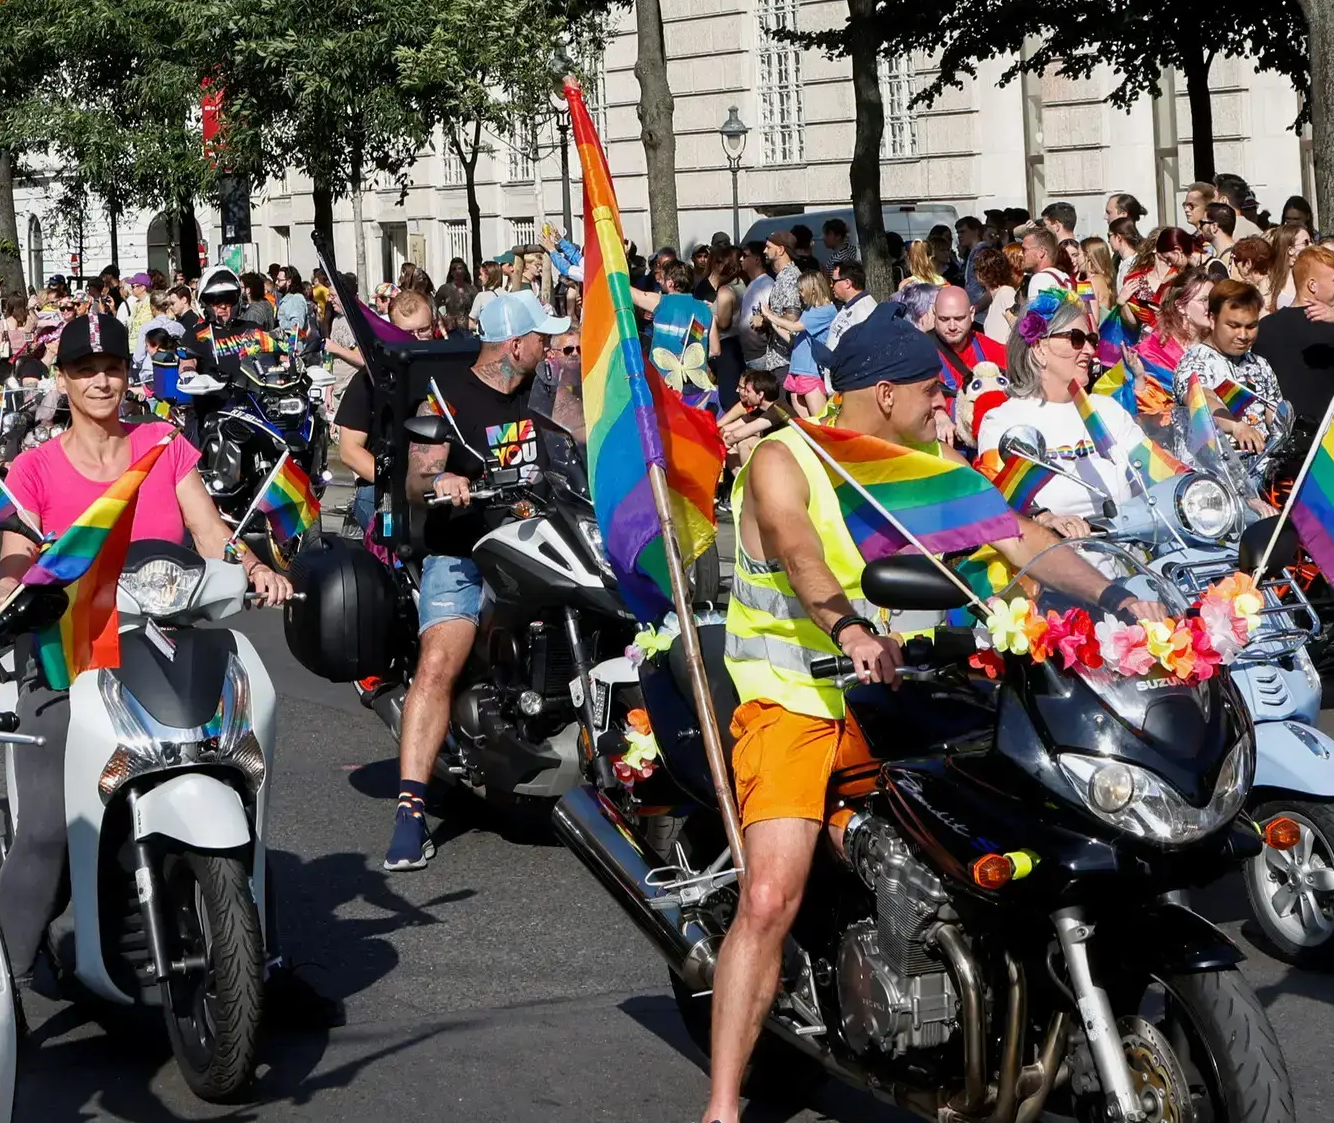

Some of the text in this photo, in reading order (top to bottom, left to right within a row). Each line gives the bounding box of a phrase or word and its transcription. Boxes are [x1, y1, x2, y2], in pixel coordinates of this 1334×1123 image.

[485, 419, 536, 447] ME
[490, 441, 538, 467] YOU
[1136, 676, 1185, 692] SUZU
